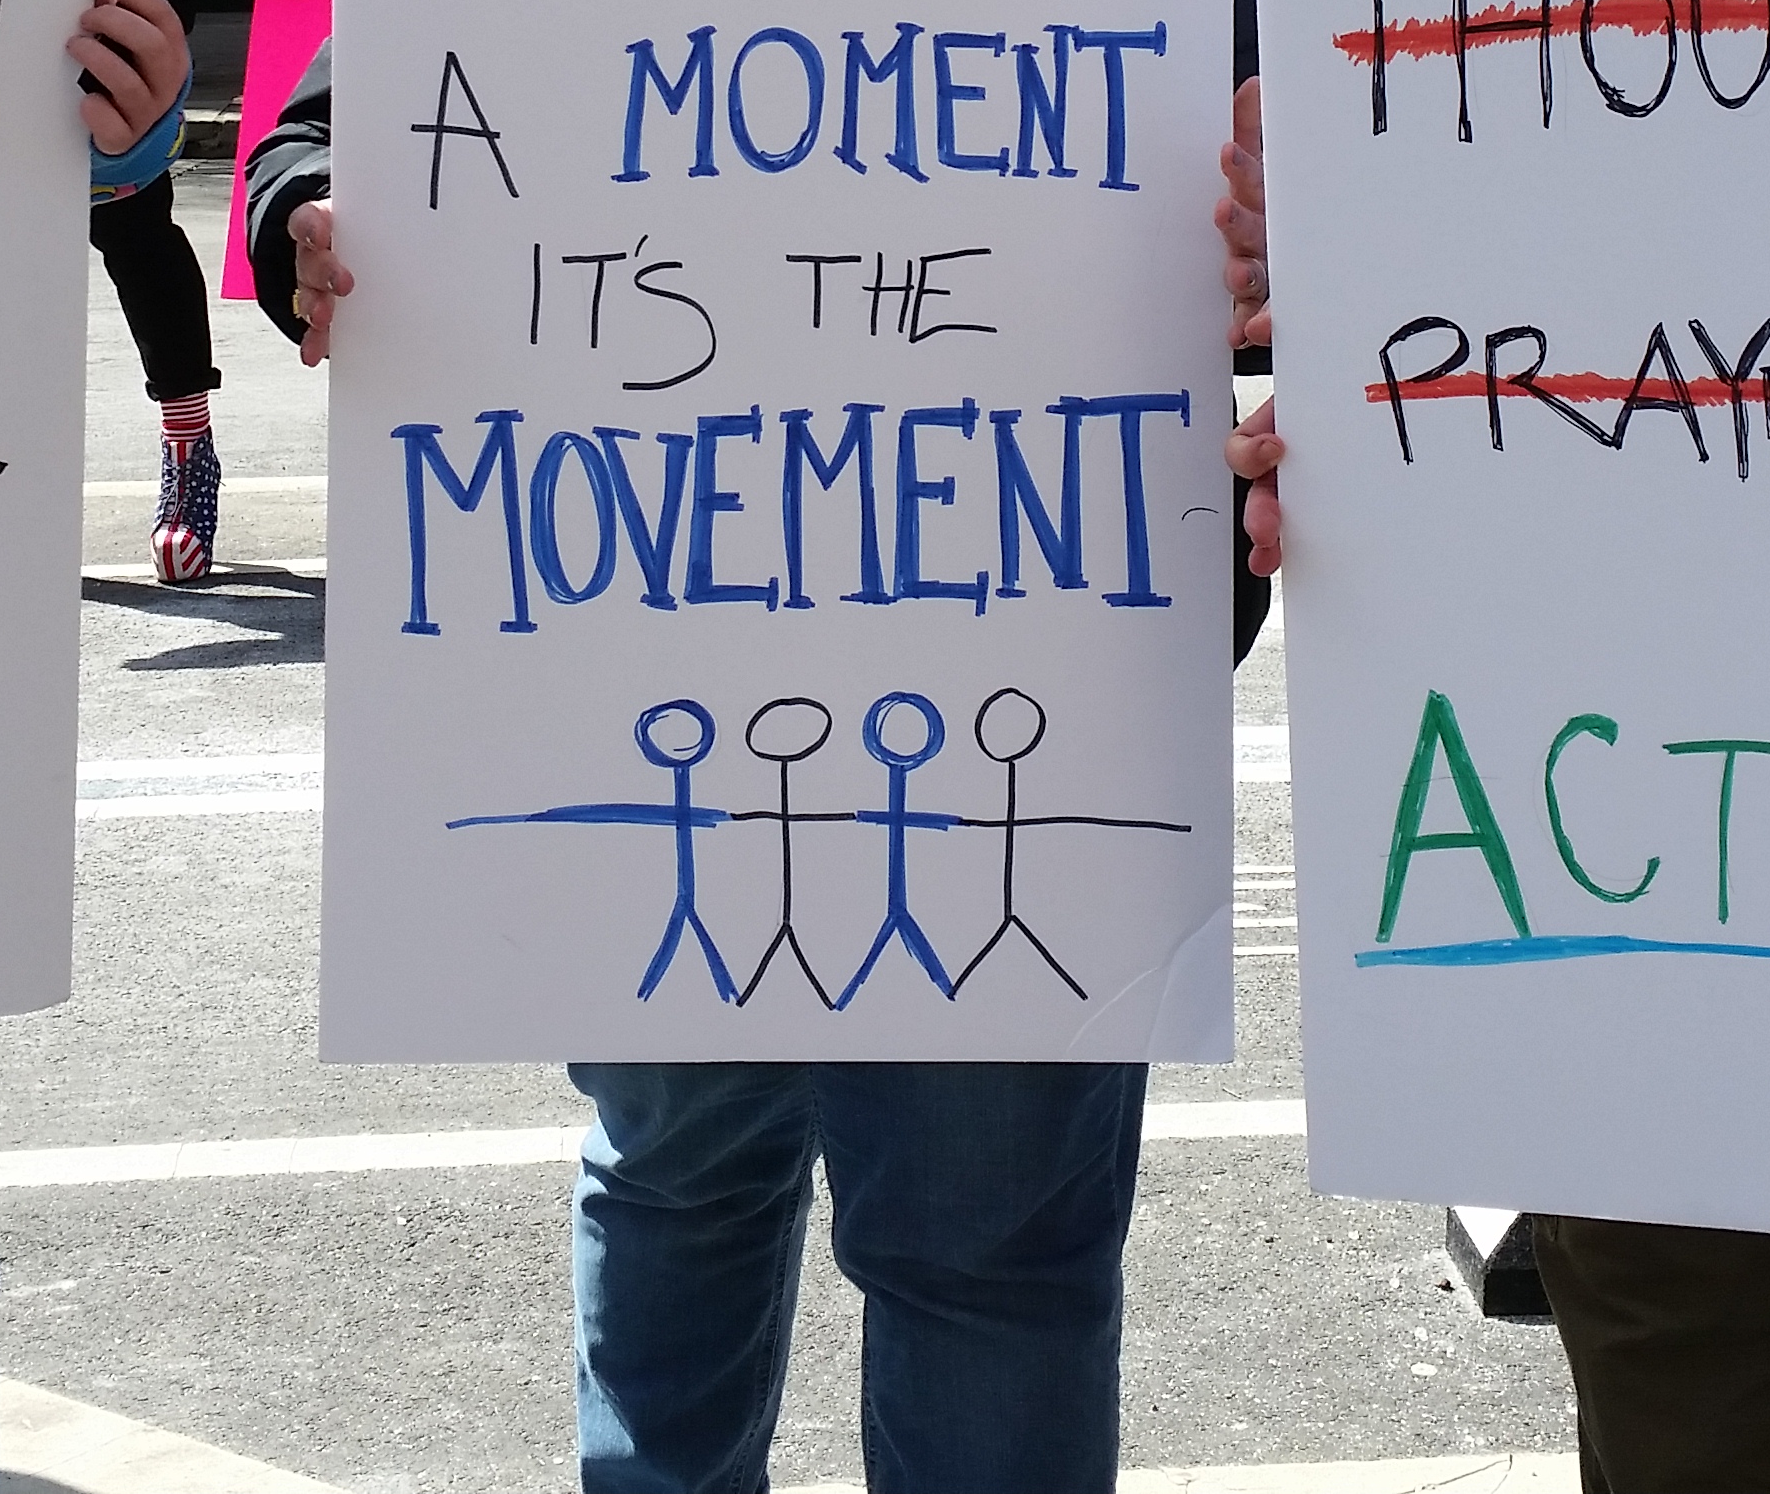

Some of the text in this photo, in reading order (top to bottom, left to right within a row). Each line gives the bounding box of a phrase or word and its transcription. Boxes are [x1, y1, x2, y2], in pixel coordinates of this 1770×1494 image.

[411, 21, 1166, 210] A MOMENT
[531, 236, 997, 390] IT'S THE
[391, 397, 1190, 635] MOVEMENT
